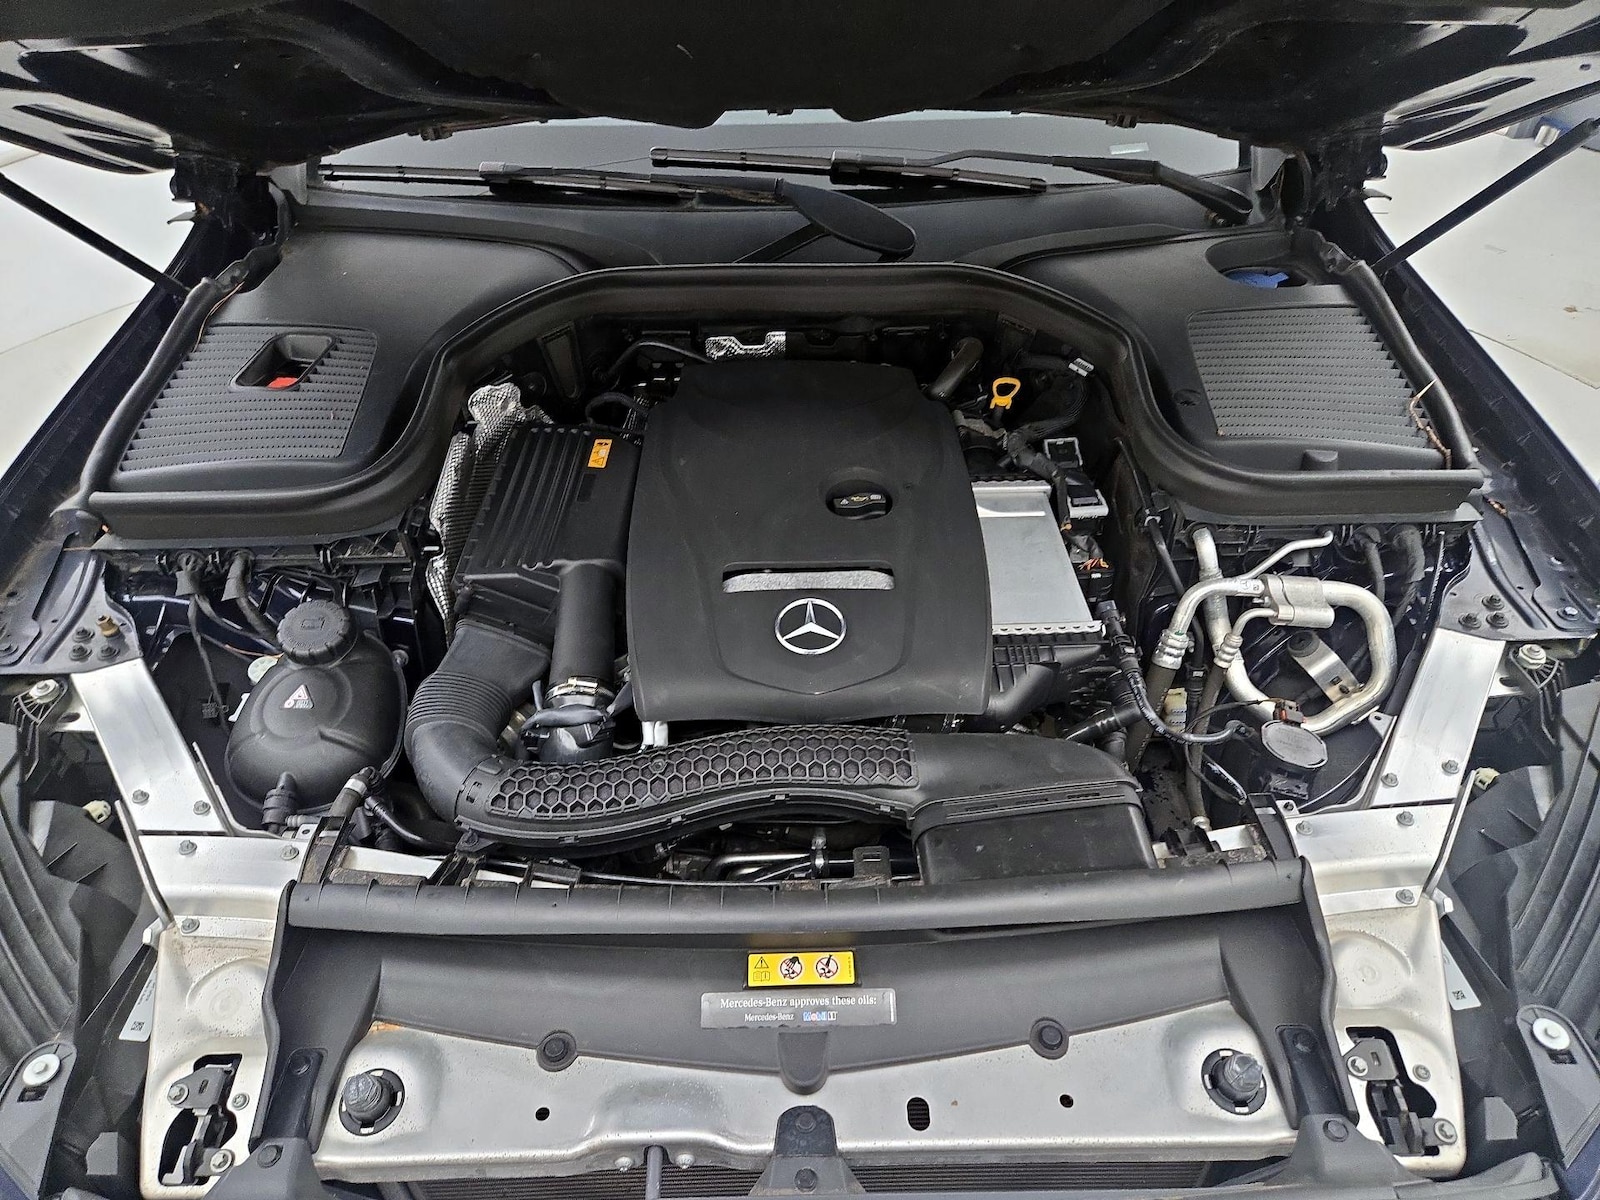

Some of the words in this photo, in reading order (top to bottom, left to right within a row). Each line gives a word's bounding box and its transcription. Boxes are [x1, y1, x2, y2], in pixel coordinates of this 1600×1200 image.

[720, 997, 787, 1008] Mercedes-Benz
[790, 997, 829, 1008] approves
[832, 995, 855, 1005] these
[744, 1012, 794, 1021] Mercedes-Benz
